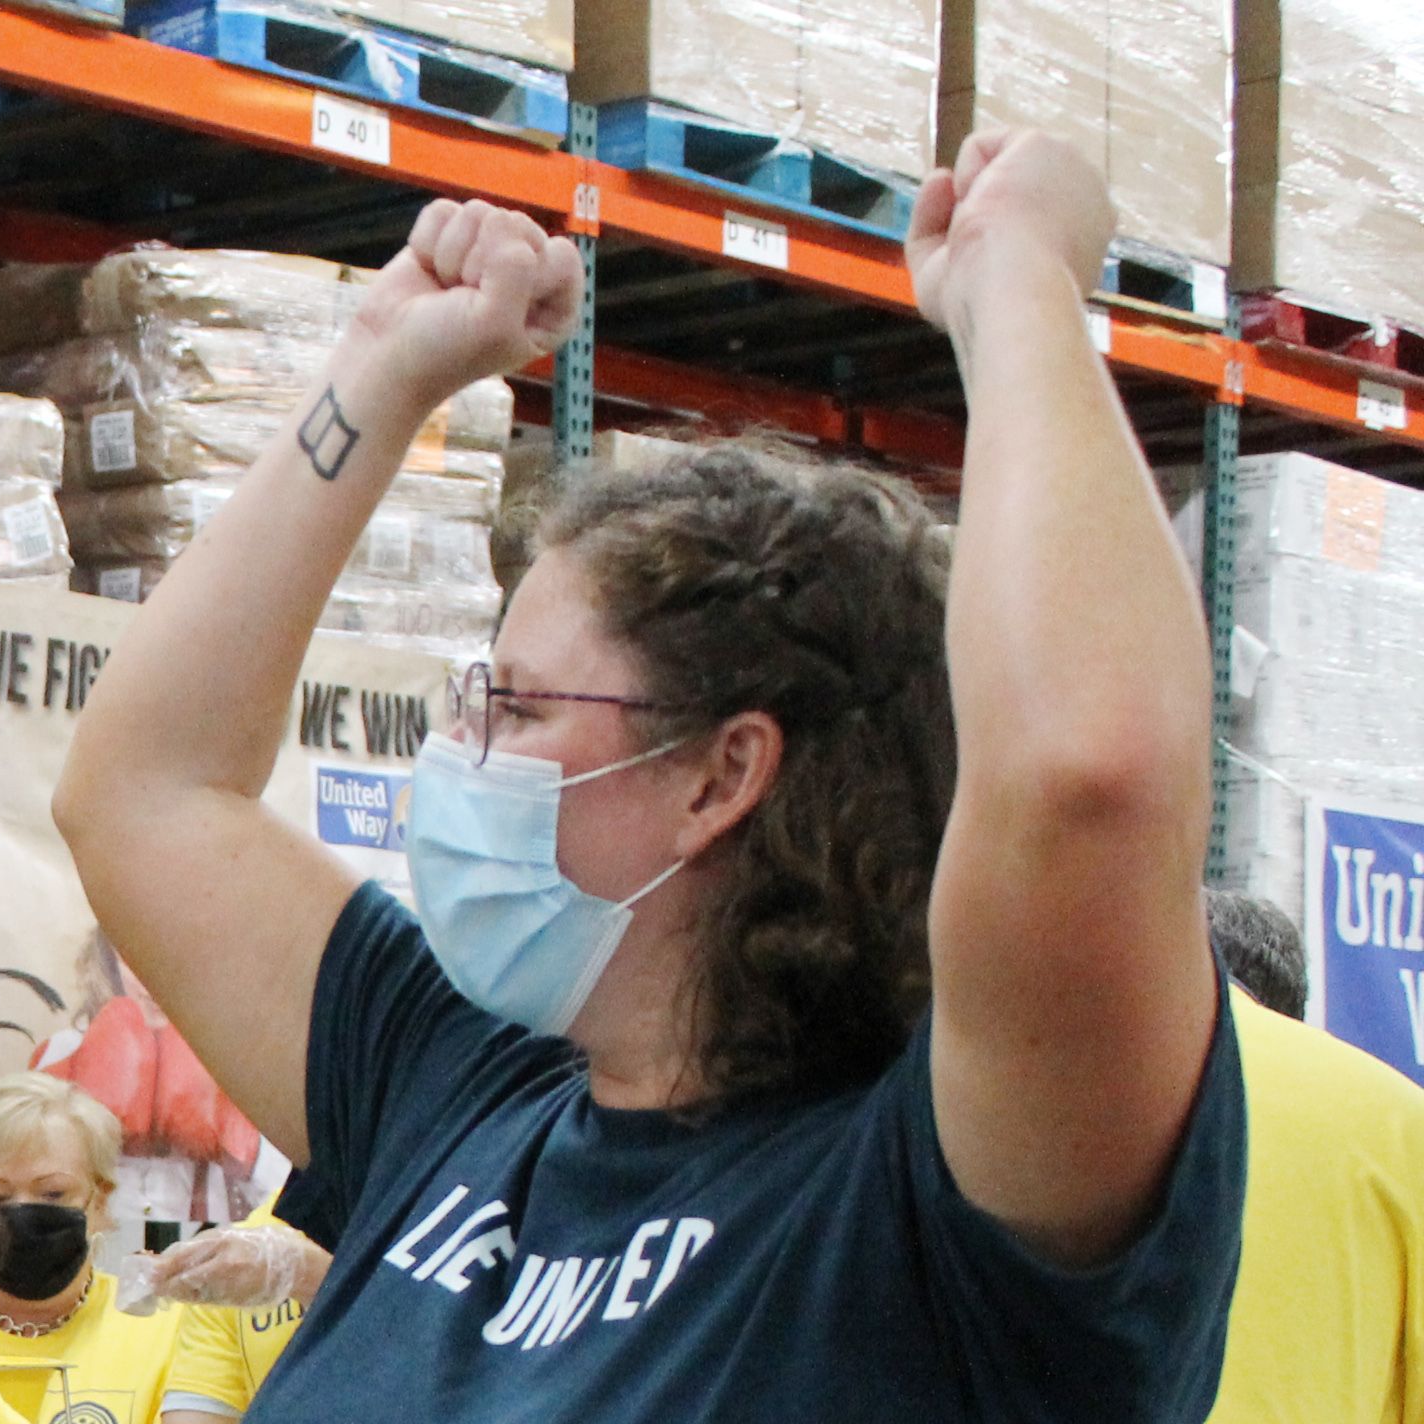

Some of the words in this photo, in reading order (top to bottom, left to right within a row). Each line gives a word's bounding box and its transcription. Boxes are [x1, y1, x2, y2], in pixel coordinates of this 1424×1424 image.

[318, 109, 331, 133] D
[346, 119, 368, 143] 40
[43, 637, 111, 710] FIG
[299, 680, 351, 751] WE
[360, 688, 431, 758] WIN
[319, 775, 389, 809] United
[344, 808, 390, 845] Way
